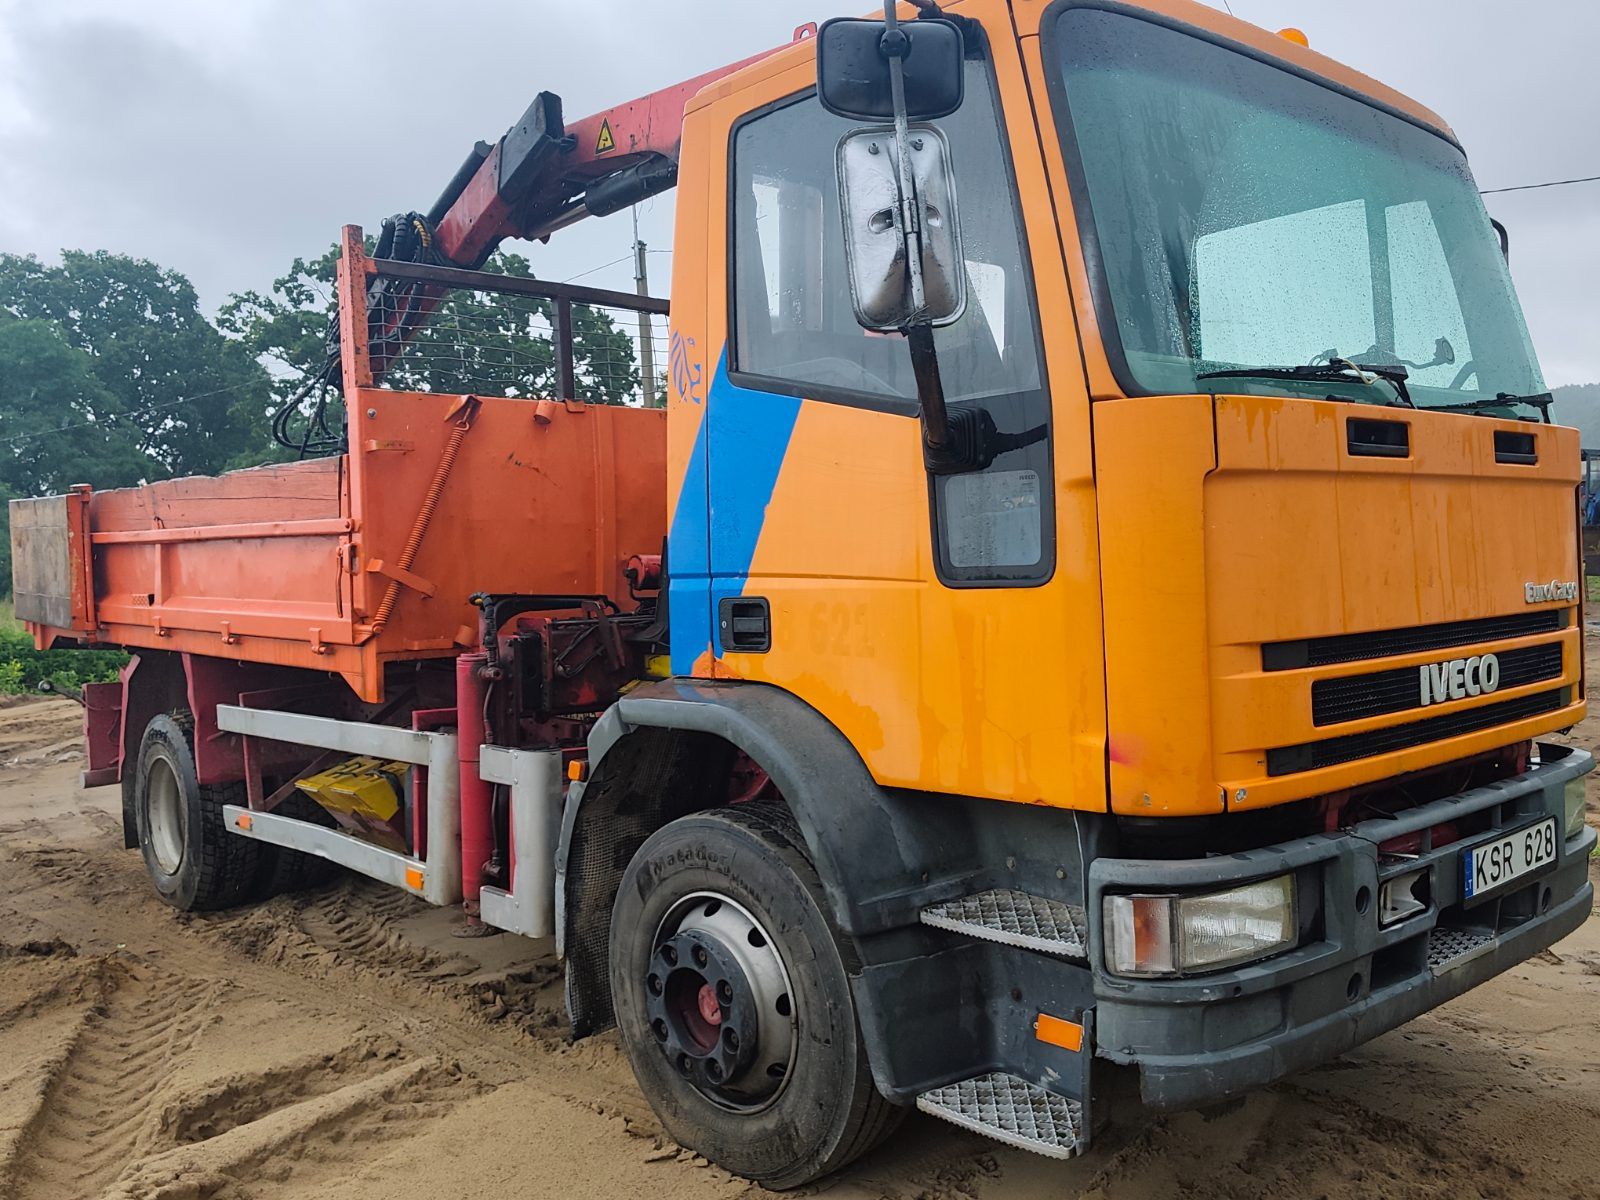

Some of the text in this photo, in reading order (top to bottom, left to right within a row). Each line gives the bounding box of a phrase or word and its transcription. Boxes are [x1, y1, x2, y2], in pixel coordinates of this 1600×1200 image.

[1420, 653, 1499, 705] IVECO
[1476, 823, 1553, 889] KSR 628
